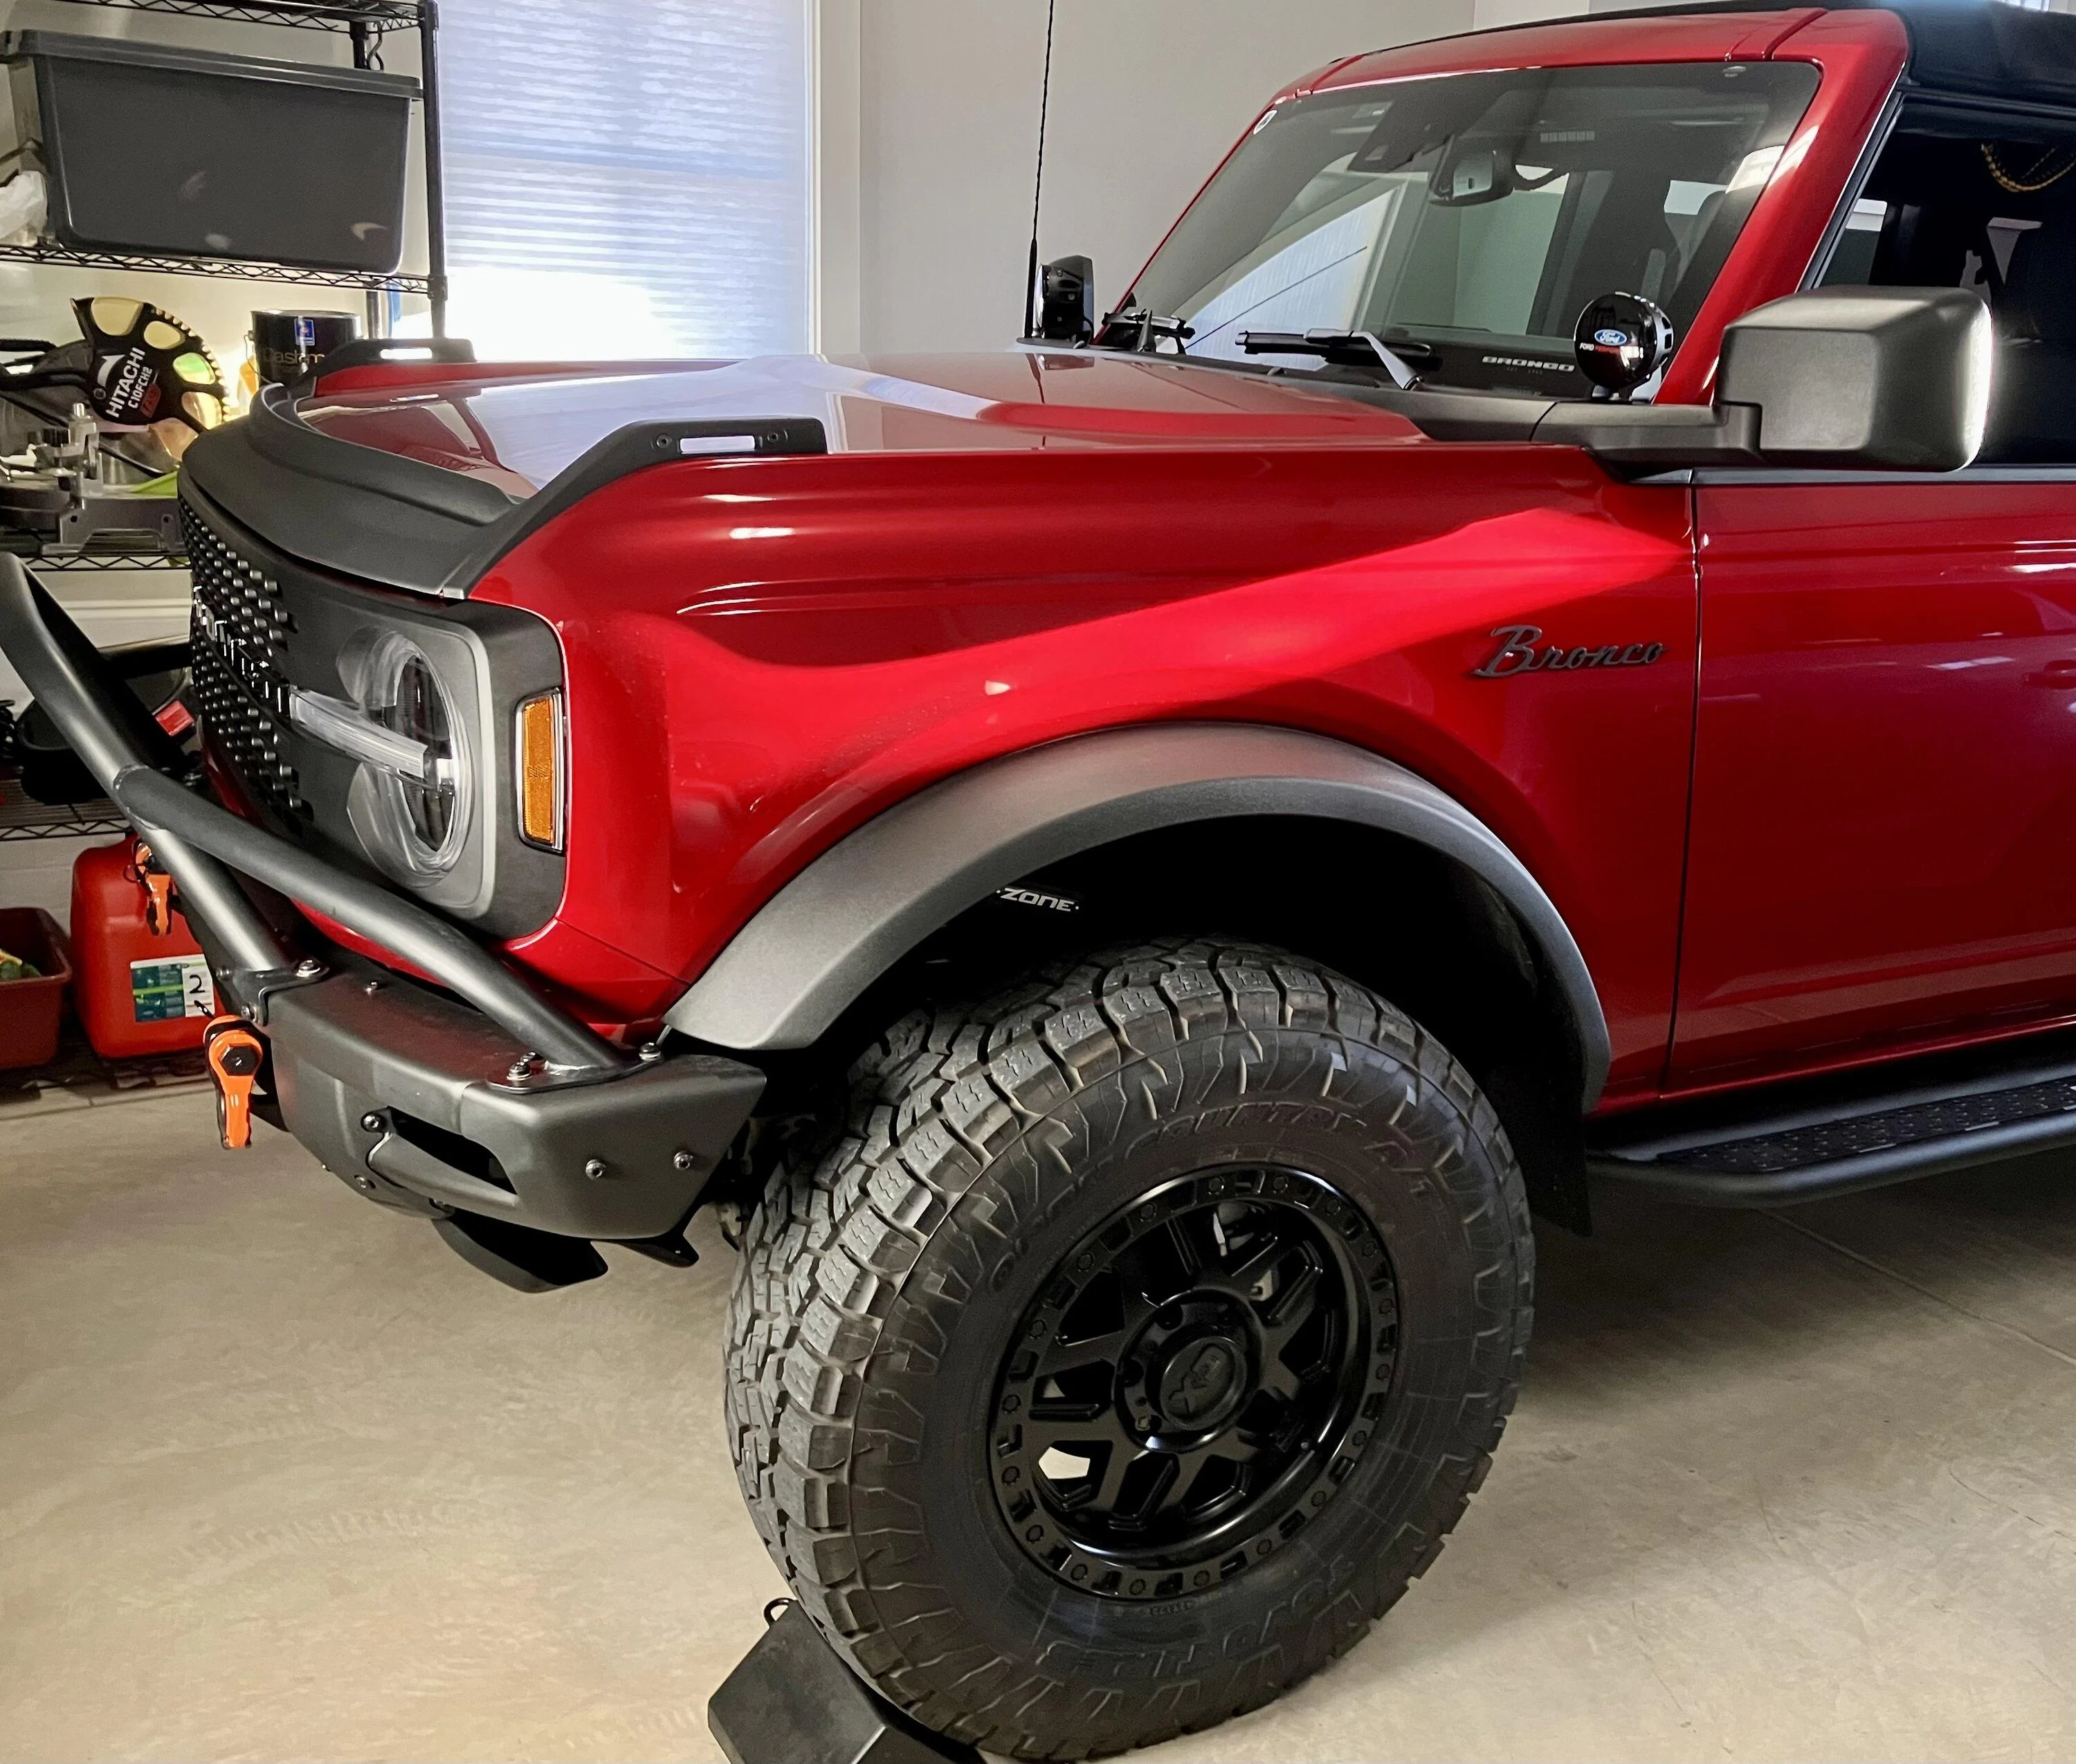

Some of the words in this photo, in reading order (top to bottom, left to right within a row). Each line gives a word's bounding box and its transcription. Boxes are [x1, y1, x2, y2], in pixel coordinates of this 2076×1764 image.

[1580, 342, 1594, 351] FORD
[105, 347, 145, 418] HITACHI
[128, 366, 152, 409] C10FCH2
[1473, 624, 1666, 677] Bronco
[1000, 887, 1075, 912] ZONE
[189, 974, 206, 994] 2
